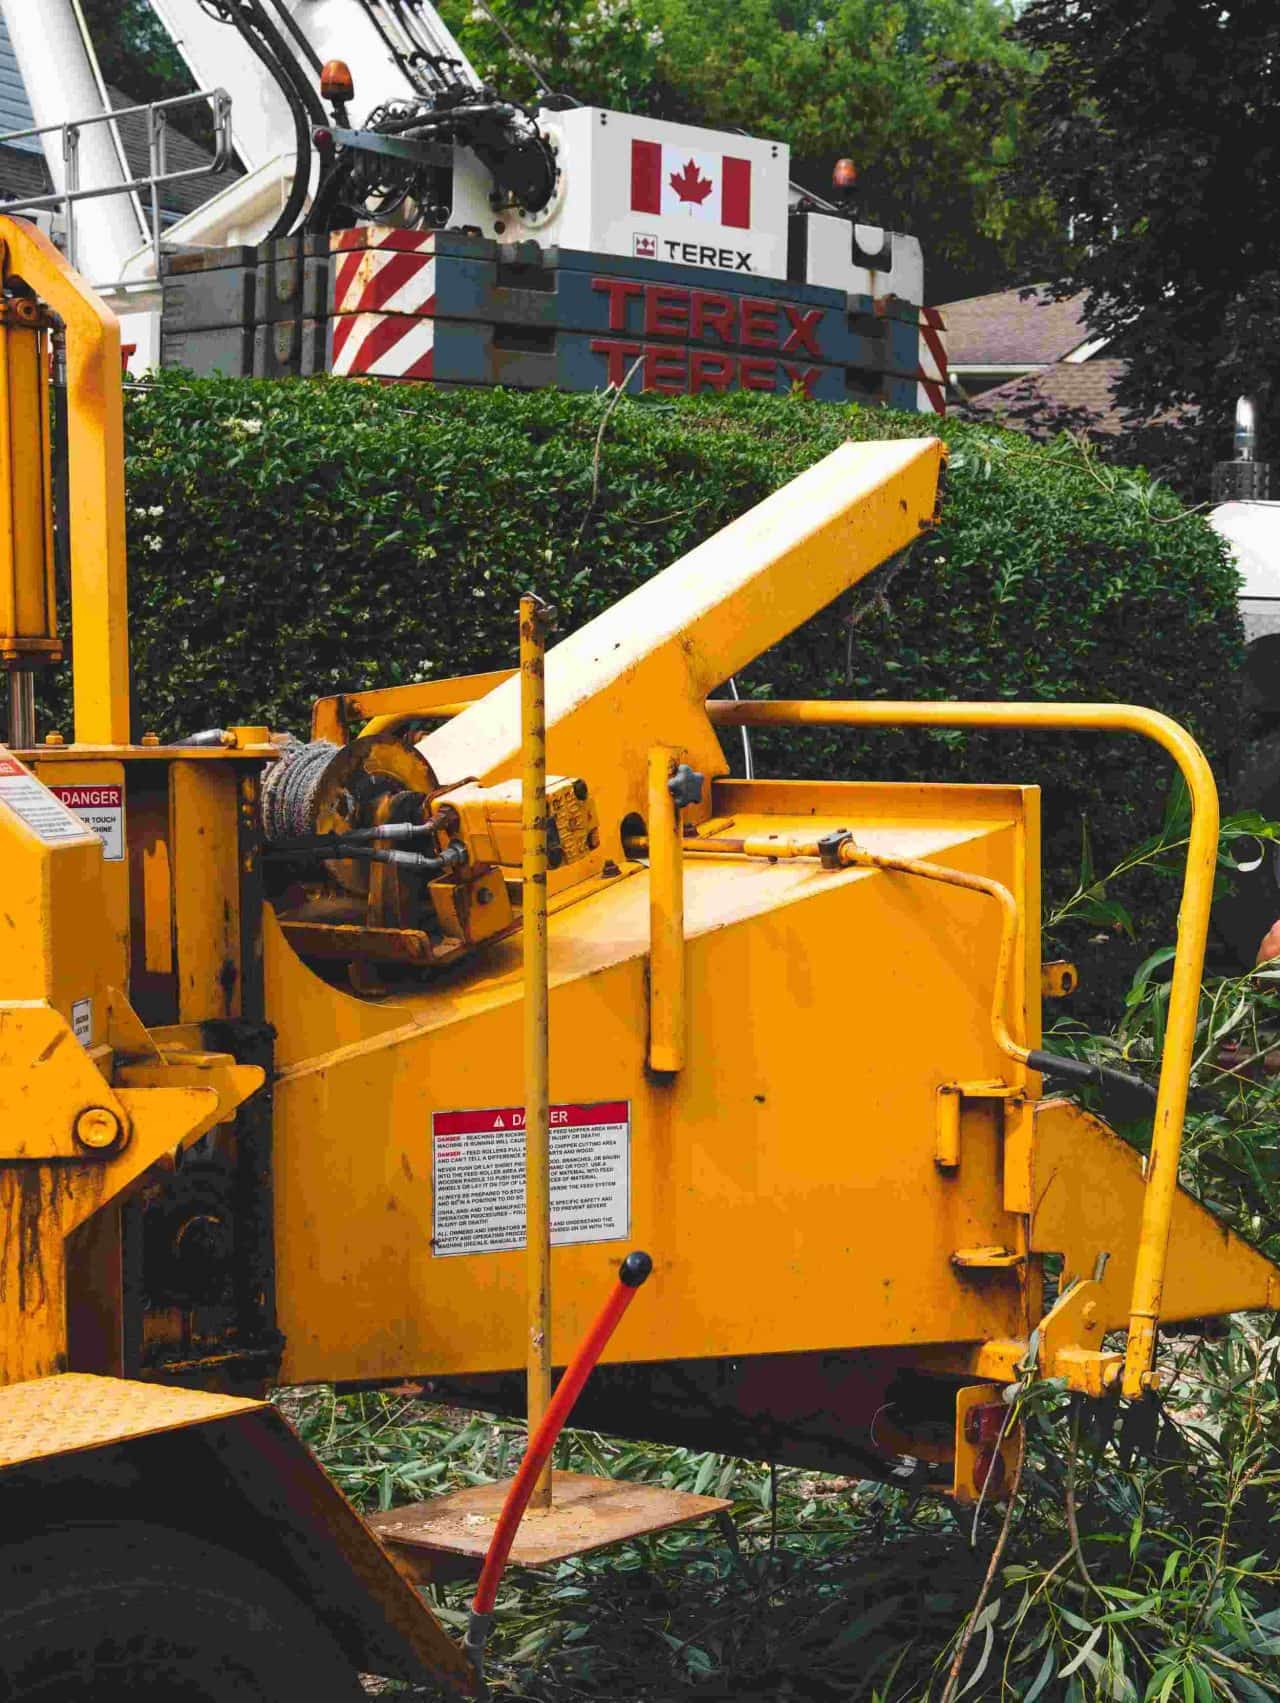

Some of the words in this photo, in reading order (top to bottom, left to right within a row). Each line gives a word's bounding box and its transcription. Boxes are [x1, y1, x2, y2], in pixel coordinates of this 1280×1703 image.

[663, 240, 753, 271] TEREX
[591, 278, 824, 358] TEREX
[60, 791, 119, 805] DANGER
